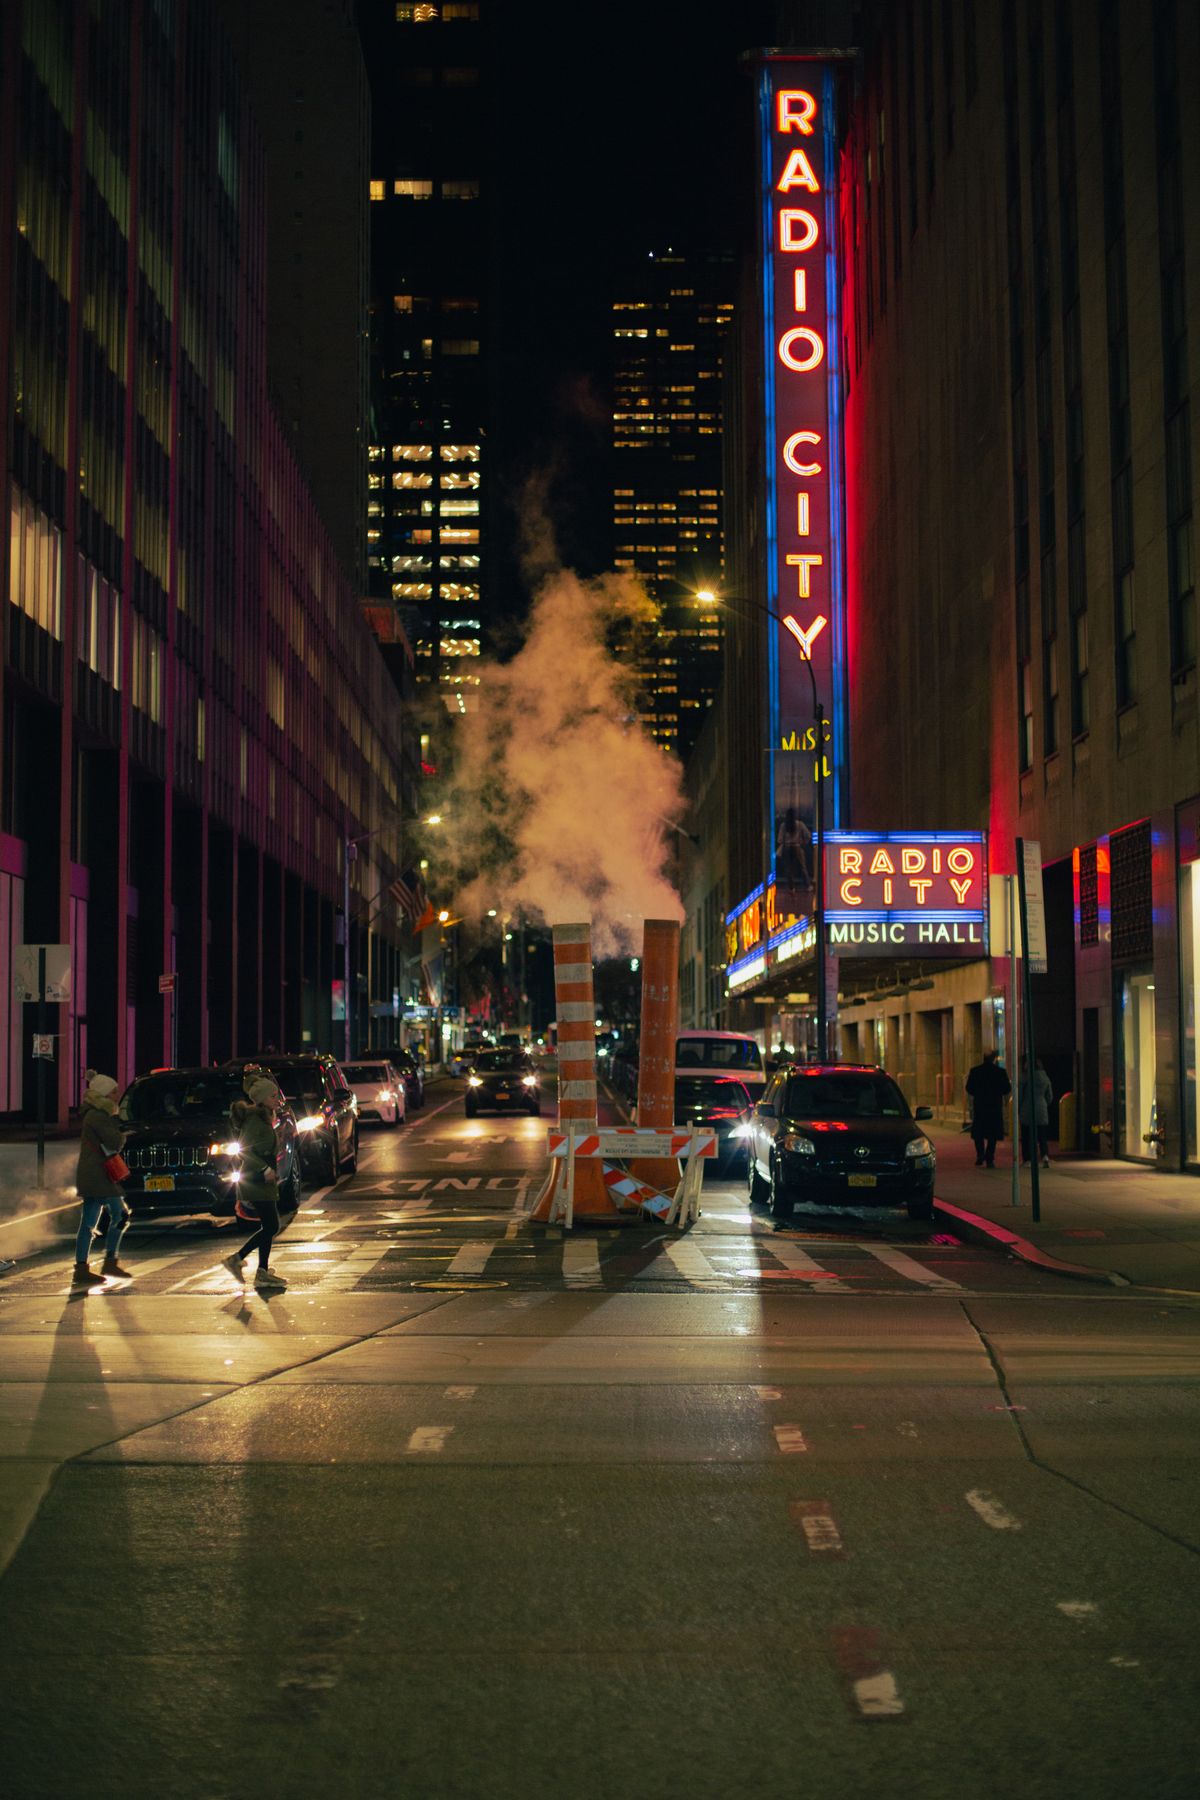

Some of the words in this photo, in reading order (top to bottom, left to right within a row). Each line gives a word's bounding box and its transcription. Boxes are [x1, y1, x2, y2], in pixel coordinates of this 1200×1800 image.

[777, 89, 824, 372] RADIO
[782, 430, 827, 660] CITY
[839, 847, 974, 875] RADIO
[840, 878, 973, 905] CITY
[830, 923, 905, 943] MUSIC
[919, 923, 982, 943] HALL
